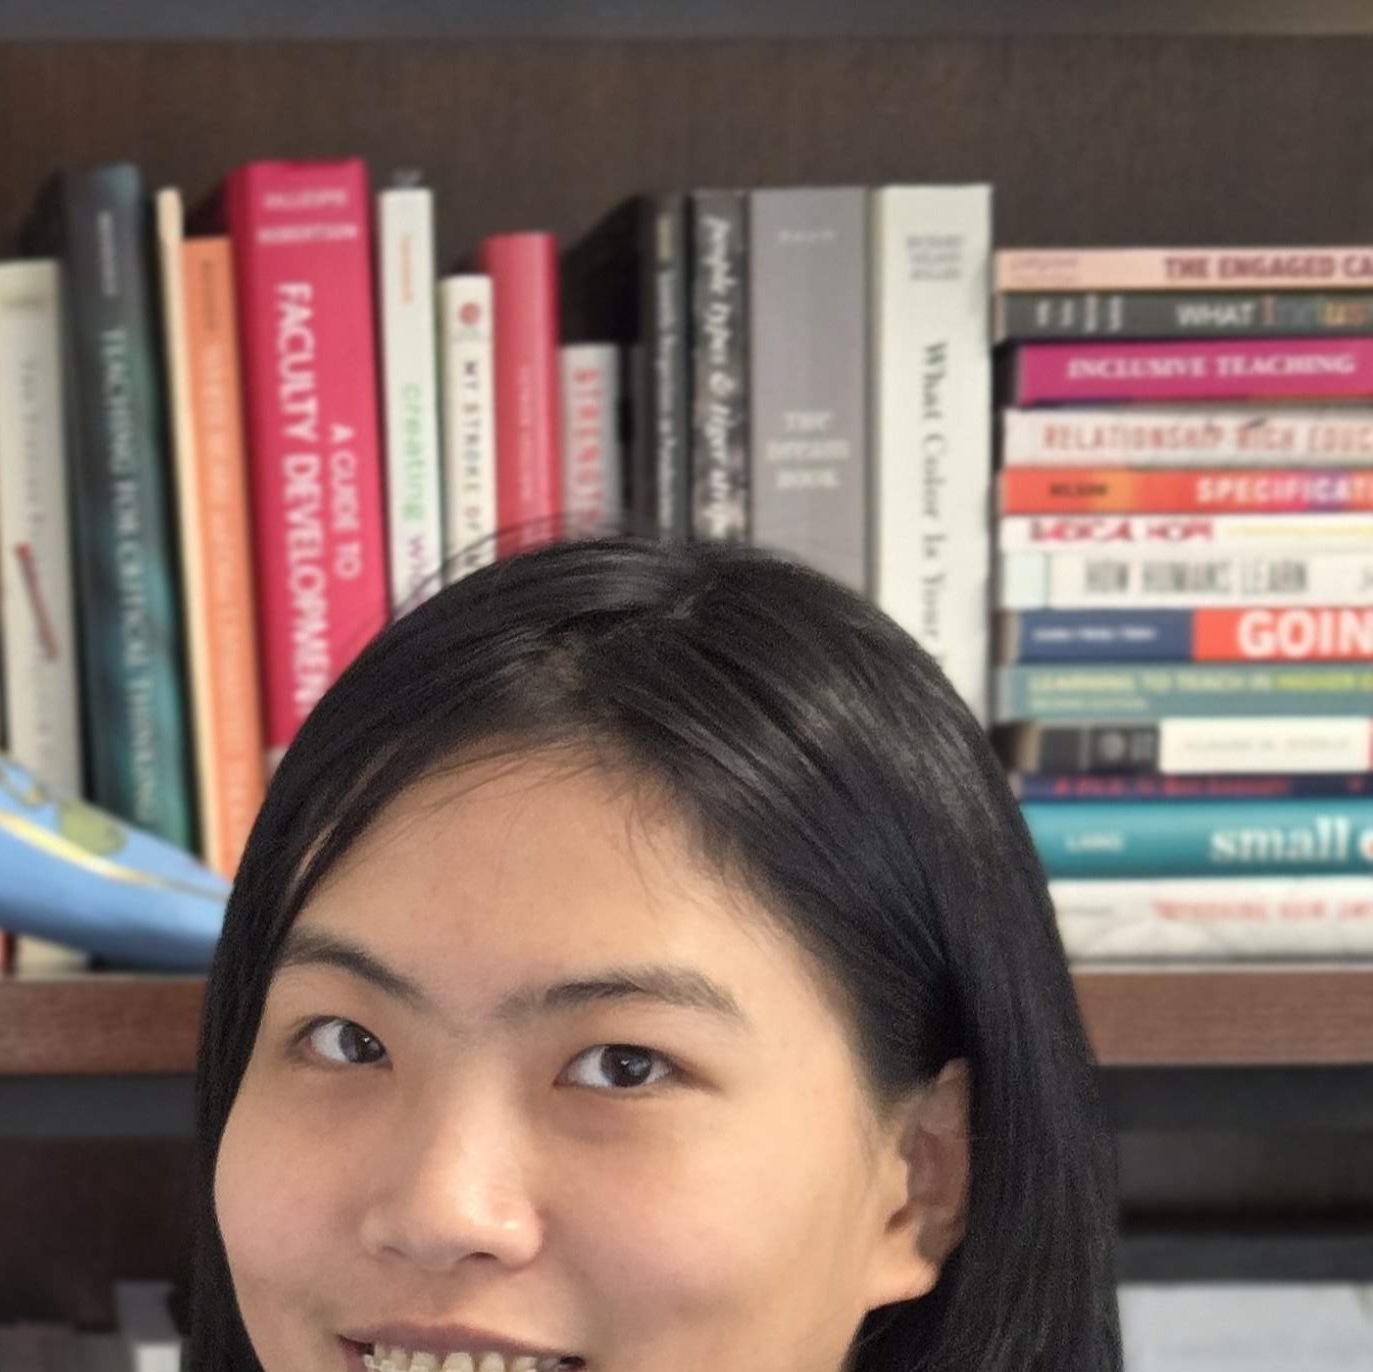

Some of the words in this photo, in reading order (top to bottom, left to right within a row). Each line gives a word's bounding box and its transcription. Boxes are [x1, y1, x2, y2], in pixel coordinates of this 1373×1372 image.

[702, 214, 736, 297] people
[1164, 256, 1210, 280] THE
[1218, 255, 1337, 280] ENGAGED
[703, 302, 731, 364] types
[1175, 301, 1254, 327] WHAT
[278, 283, 321, 442] FACULTY
[462, 360, 480, 393] MY
[921, 340, 948, 421] What
[1066, 356, 1207, 379] INCLUSIVE
[1215, 353, 1356, 376] TEACHING
[331, 422, 356, 444] A
[399, 381, 432, 521] creating
[463, 403, 483, 494] STROKE
[704, 403, 735, 466] tiger
[331, 451, 361, 532] GUIDE
[922, 432, 947, 520] Color
[334, 541, 362, 581] TO
[923, 532, 946, 560] Is
[1085, 559, 1130, 592] HOW
[1140, 559, 1234, 593] HUMANS
[1241, 559, 1309, 593] LEARN
[921, 571, 946, 643] Your
[1210, 814, 1353, 863] small
